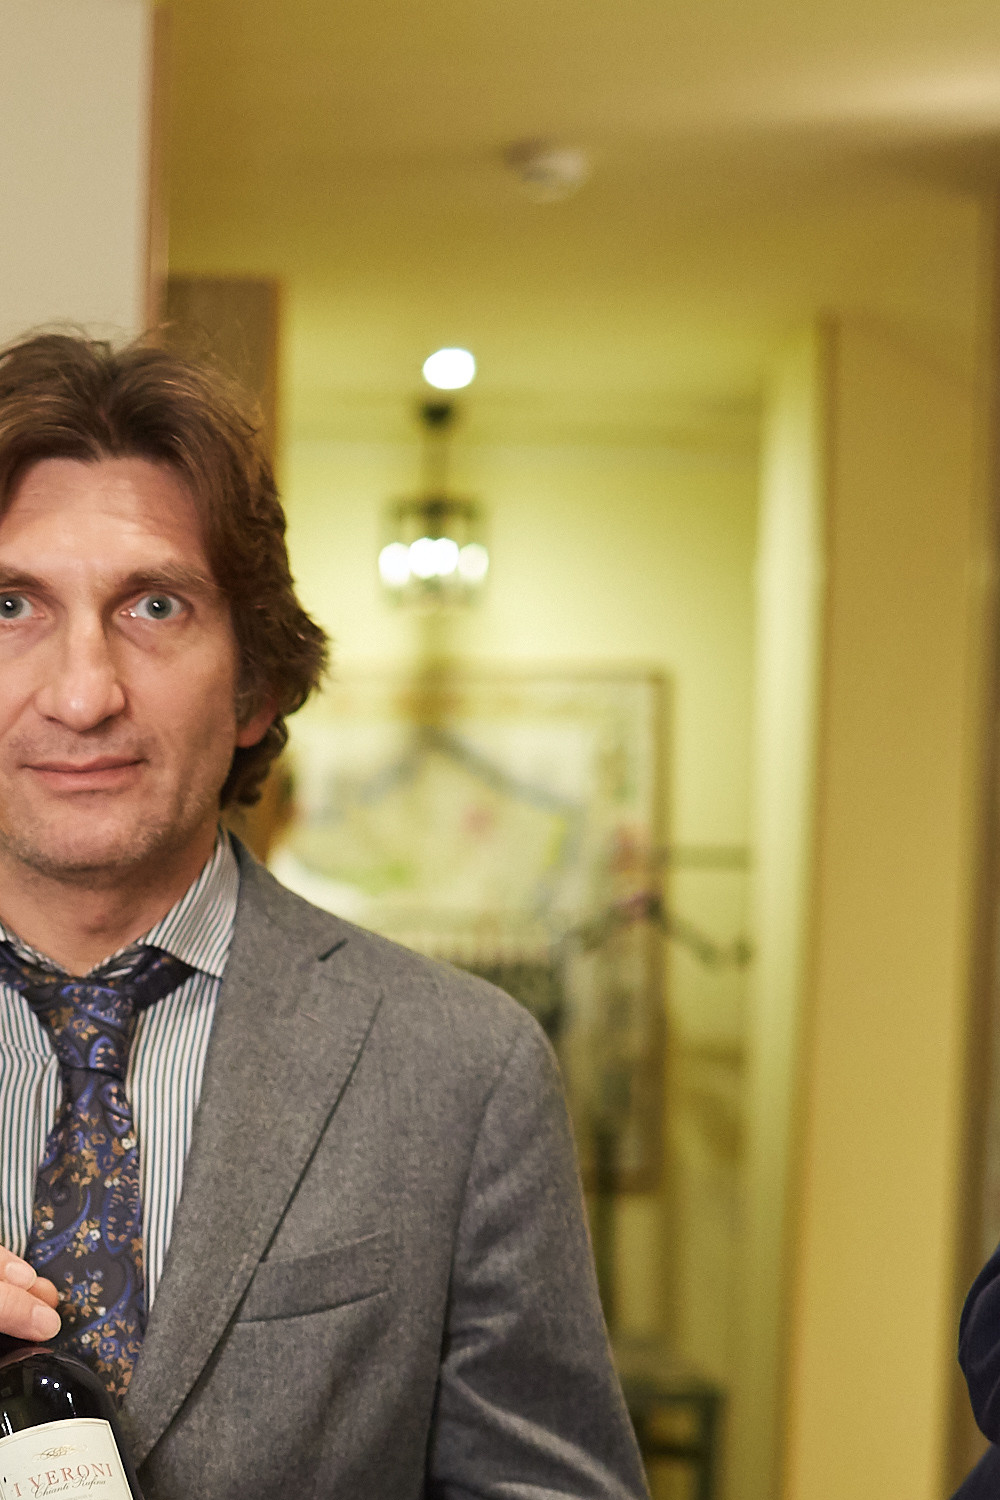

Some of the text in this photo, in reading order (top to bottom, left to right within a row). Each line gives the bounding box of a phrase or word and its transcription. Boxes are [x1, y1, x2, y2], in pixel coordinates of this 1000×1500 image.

[13, 1463, 113, 1498] I VERONI
[31, 1481, 69, 1500] Chianti
